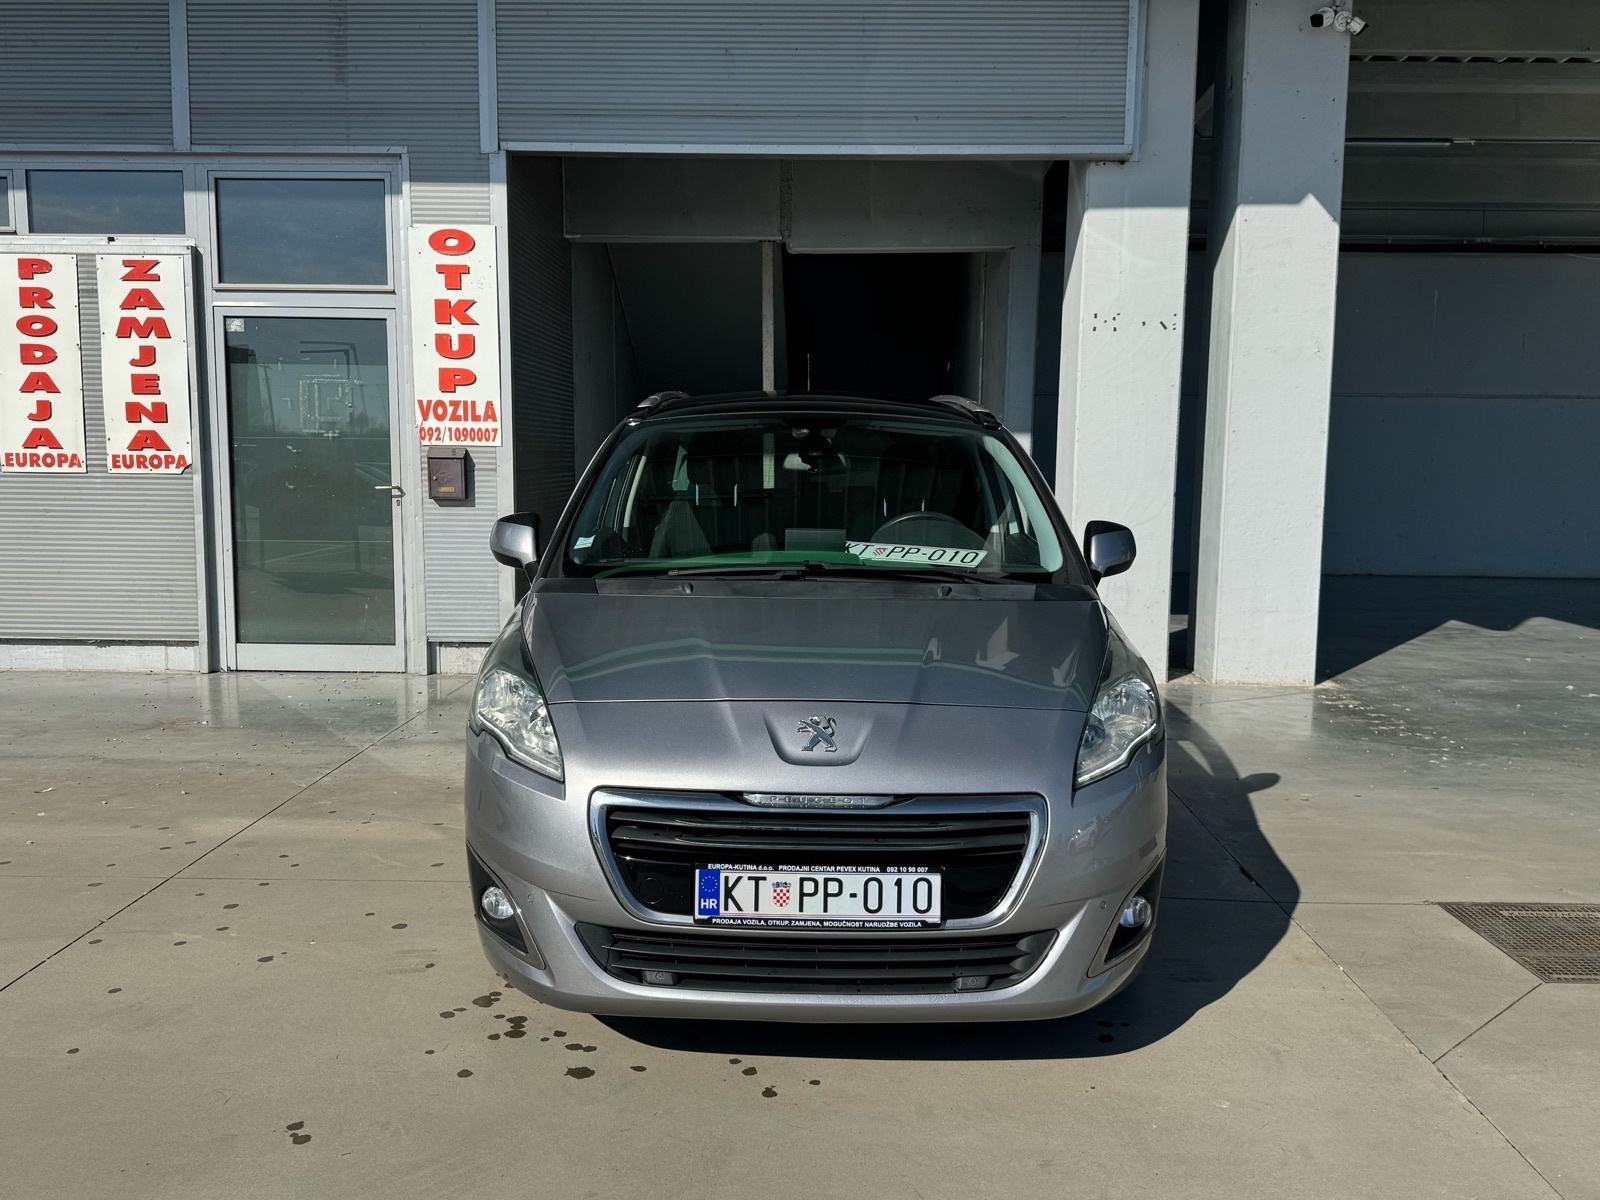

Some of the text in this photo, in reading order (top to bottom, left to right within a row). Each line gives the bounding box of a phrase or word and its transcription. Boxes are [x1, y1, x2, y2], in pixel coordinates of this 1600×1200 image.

[428, 229, 480, 393] OTKUP
[16, 258, 63, 449] PRODAJA
[116, 259, 171, 451] ZAMJENA
[417, 399, 498, 423] VOZILA
[418, 427, 498, 443] 092/1090007
[4, 452, 83, 468] EUROPA
[111, 454, 188, 470] EUROPA
[885, 546, 979, 564] PP-010
[707, 863, 758, 871] EUROPA-KUTINA
[723, 875, 933, 914] KT PP-010
[700, 898, 718, 910] HR
[864, 920, 898, 928] NARUDŽBE
